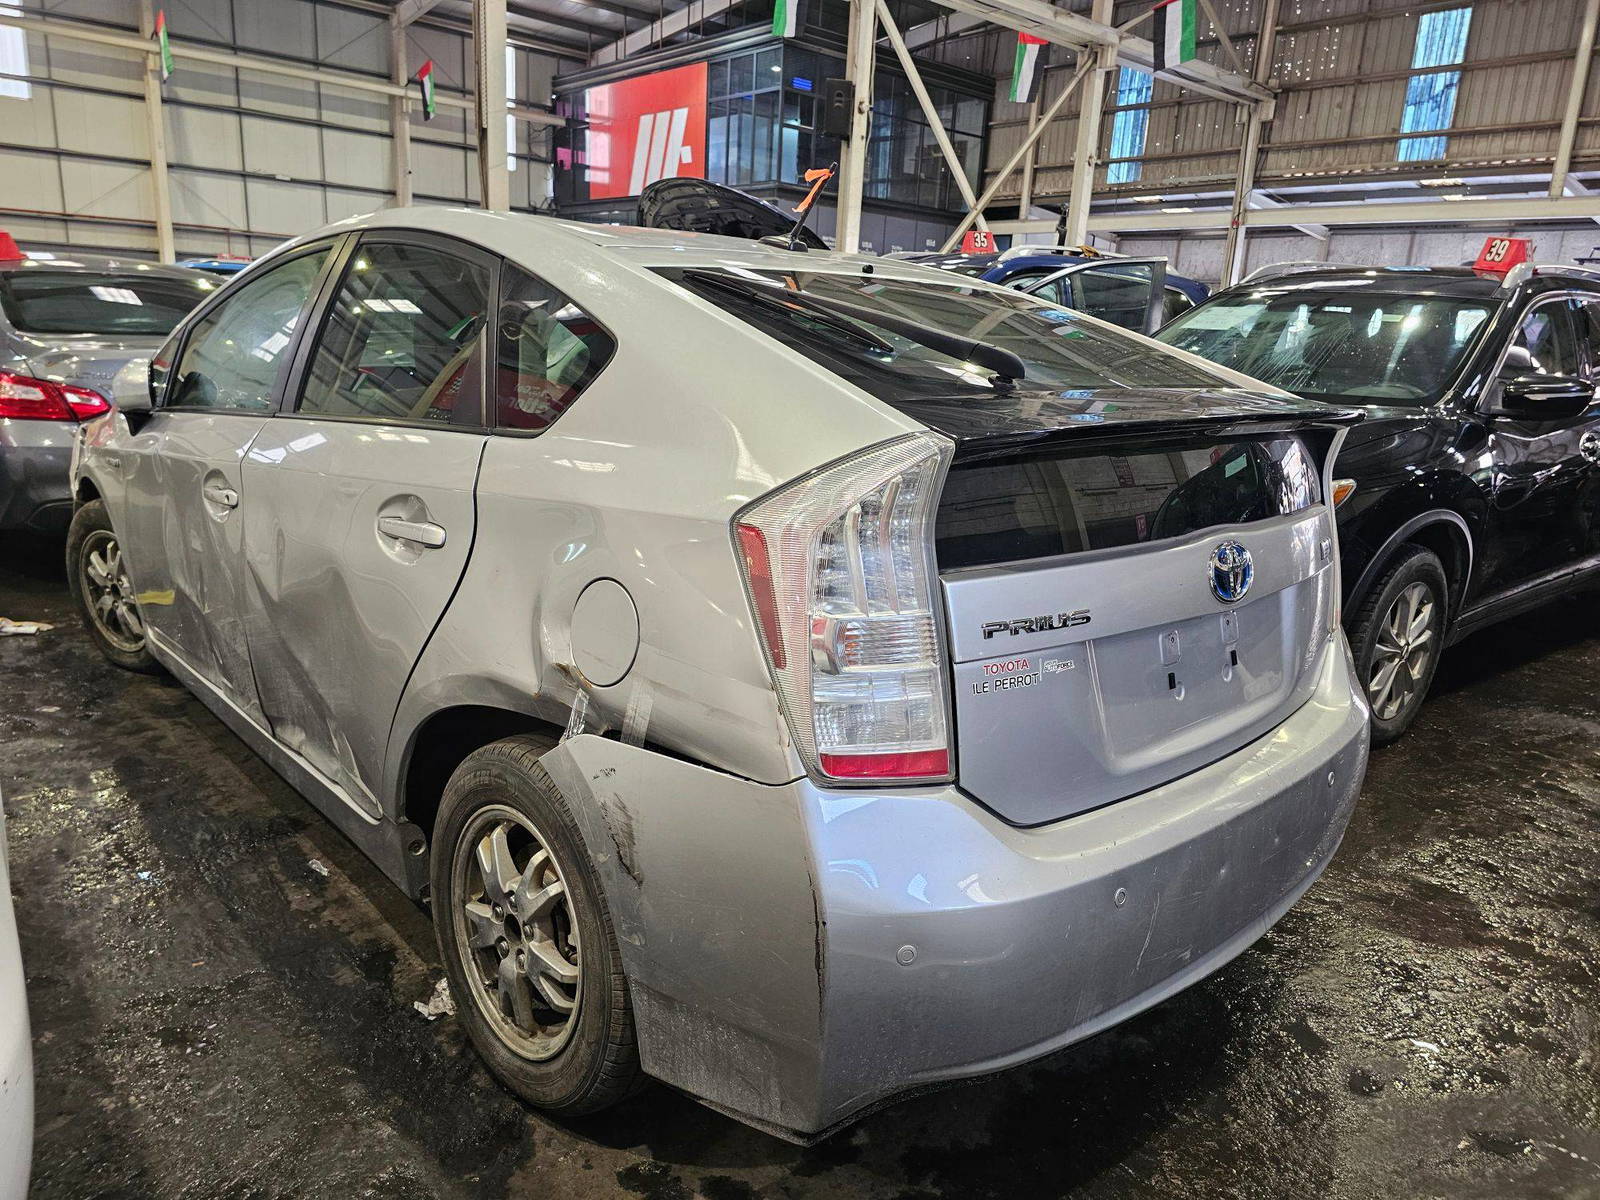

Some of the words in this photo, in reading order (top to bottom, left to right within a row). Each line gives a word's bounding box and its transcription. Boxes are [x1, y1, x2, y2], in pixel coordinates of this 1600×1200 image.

[974, 232, 988, 248] 35
[1485, 239, 1510, 262] 39
[982, 609, 1091, 640] PRIUS
[983, 659, 1029, 676] TOYOTA
[972, 681, 989, 695] ILE
[994, 672, 1039, 692] PERROT
